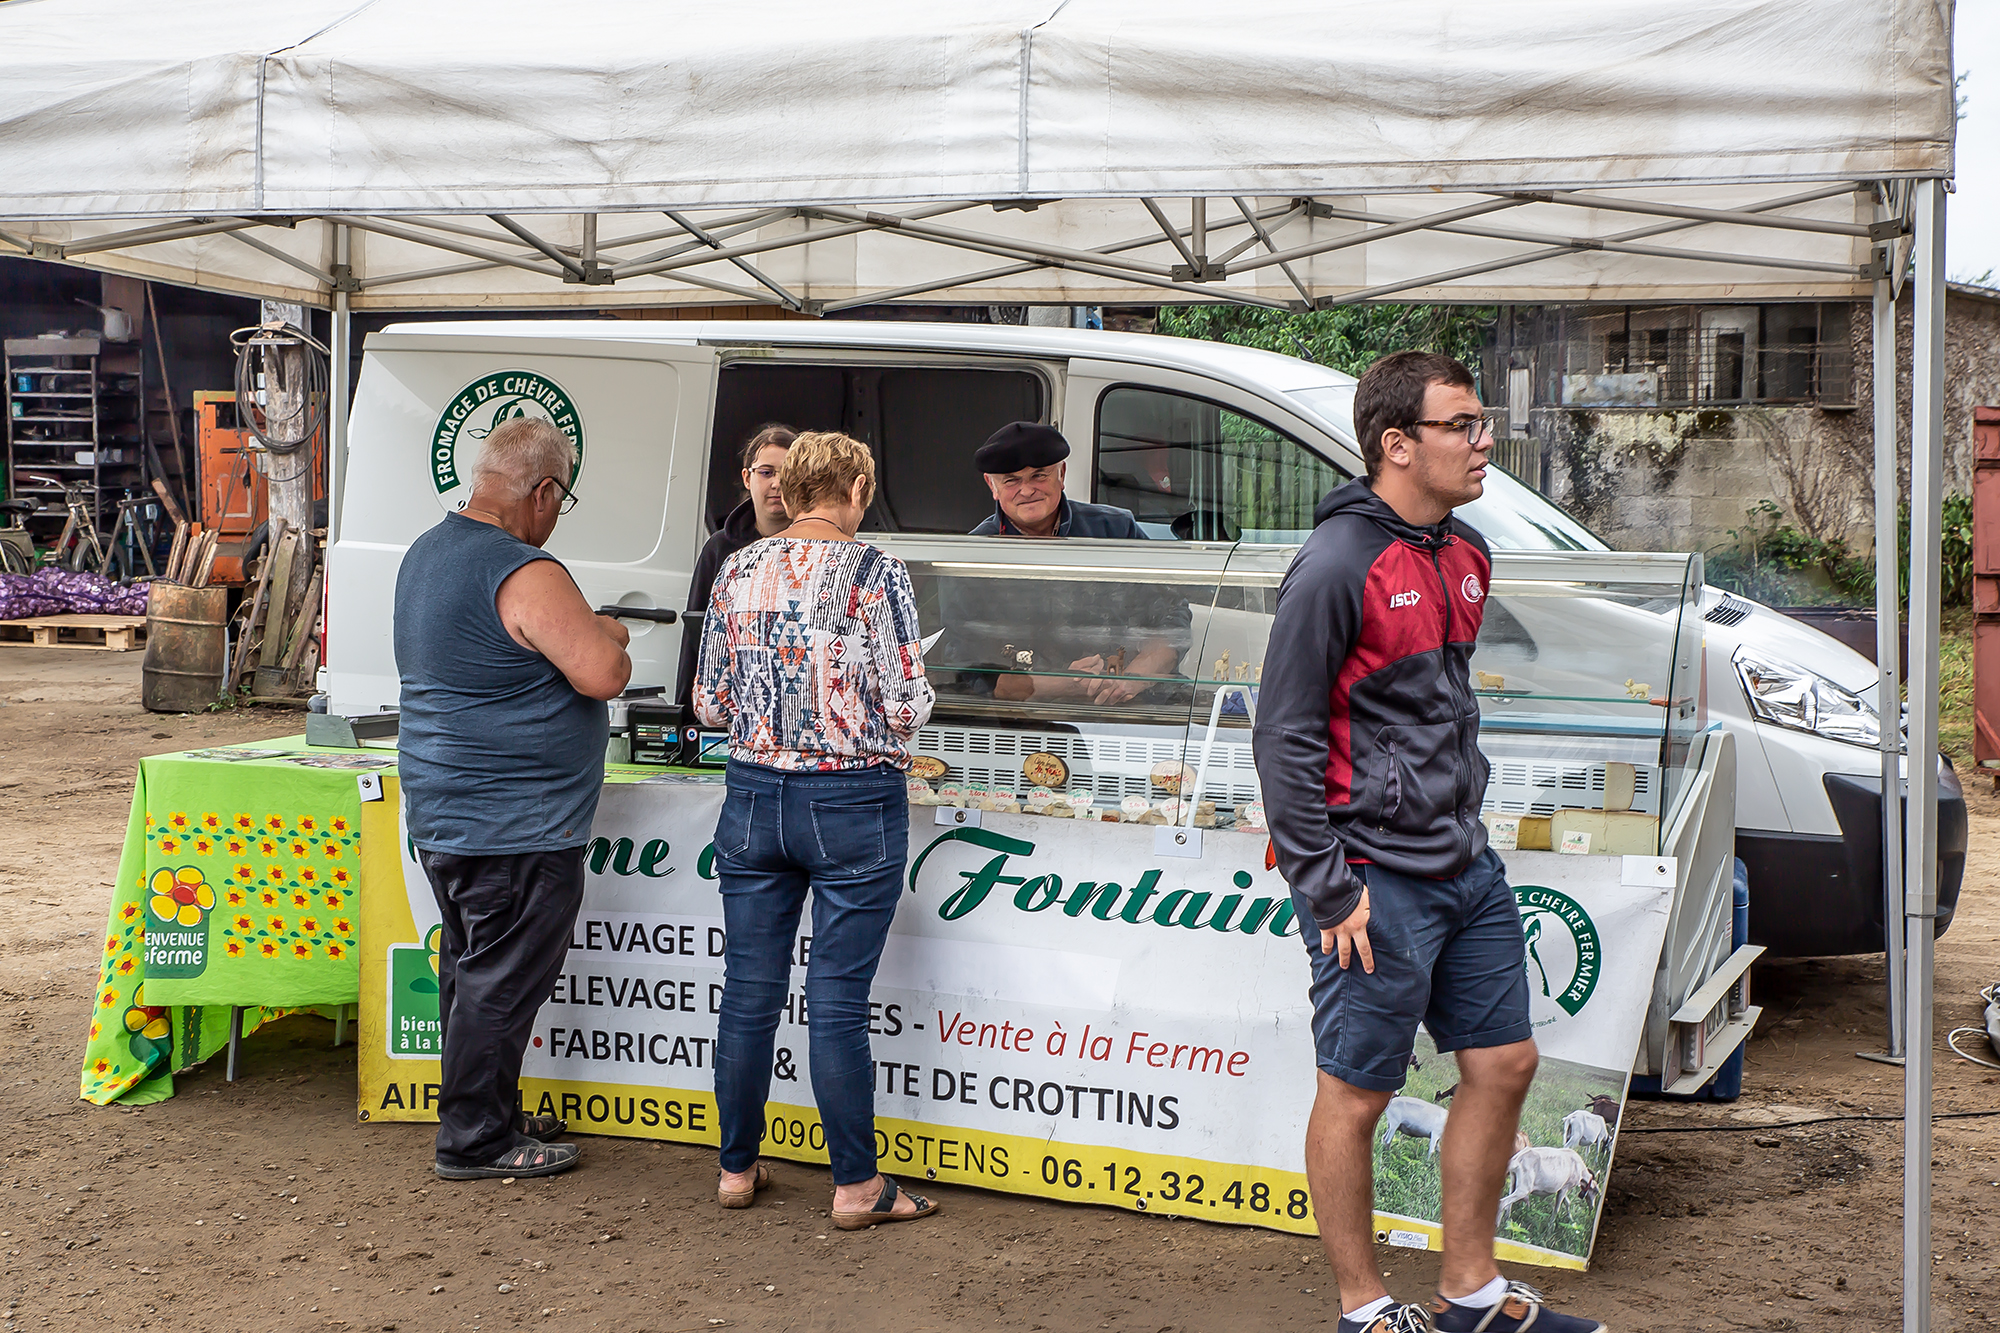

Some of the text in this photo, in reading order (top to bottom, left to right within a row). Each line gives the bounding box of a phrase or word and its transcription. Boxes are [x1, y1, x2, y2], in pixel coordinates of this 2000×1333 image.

[436, 377, 566, 486] FROMAGE DE CHÈVRE
[909, 826, 1301, 938] Fontain
[145, 932, 205, 947] ENVENUE
[149, 946, 203, 965] ferme
[570, 920, 727, 957] LEVAGE D
[1515, 891, 1595, 1002] E CHEVRE FERMIER
[400, 1033, 409, 1049] à
[415, 1034, 431, 1050] la
[550, 1027, 717, 1069] FABRICATI
[773, 1047, 798, 1082] &
[932, 1067, 978, 1105] DE
[988, 1075, 1180, 1131] CROTTINS
[938, 1010, 1034, 1052] Vente
[1046, 1021, 1067, 1057] à
[1078, 1025, 1113, 1061] la
[1126, 1031, 1250, 1077] Ferme
[380, 1083, 441, 1110] AIR
[518, 1088, 707, 1131] LAROUSSE
[875, 1129, 1009, 1178] OSTENS
[1041, 1155, 1310, 1220] 06.12.32.48.8
